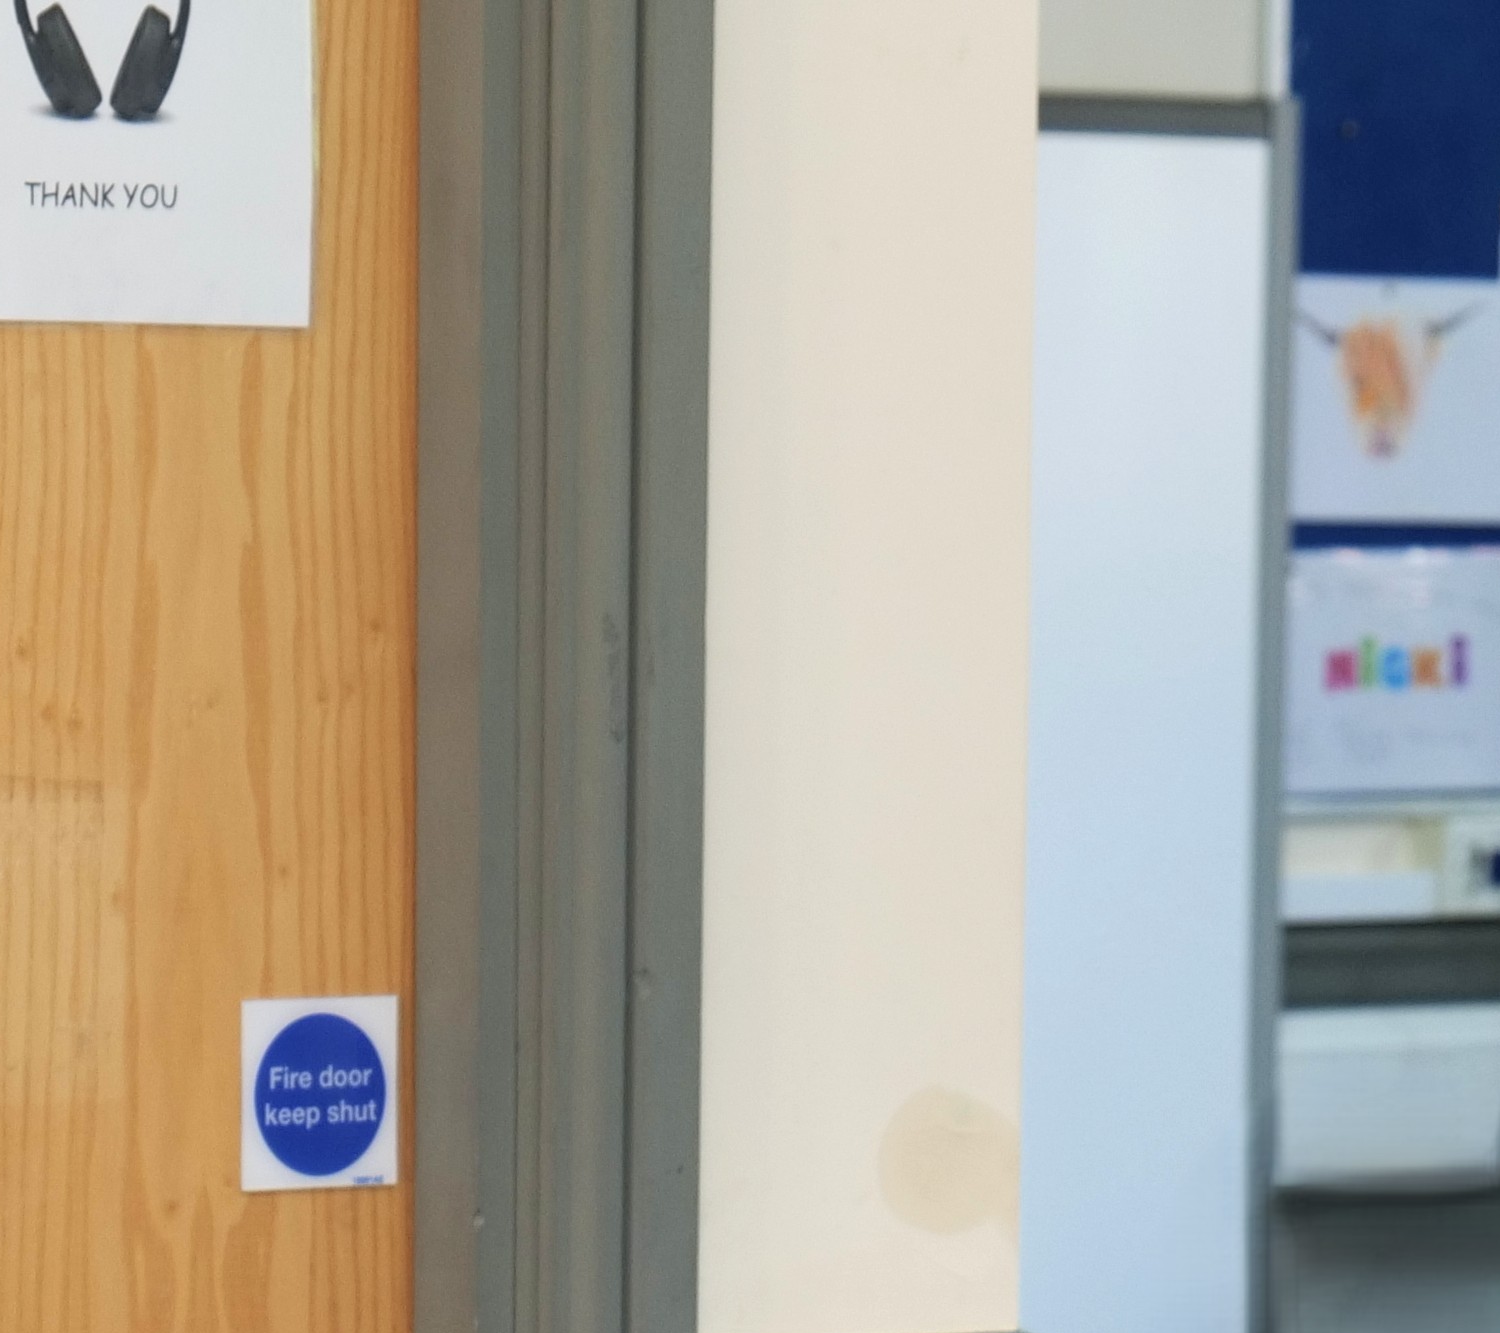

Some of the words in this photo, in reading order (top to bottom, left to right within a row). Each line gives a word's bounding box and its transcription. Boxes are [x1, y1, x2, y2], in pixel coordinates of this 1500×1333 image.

[24, 179, 114, 210] THANK
[122, 182, 179, 212] YOU
[268, 1066, 313, 1090] Fire
[318, 1064, 374, 1089] door
[264, 1103, 322, 1130] keep
[326, 1099, 378, 1124] shut
